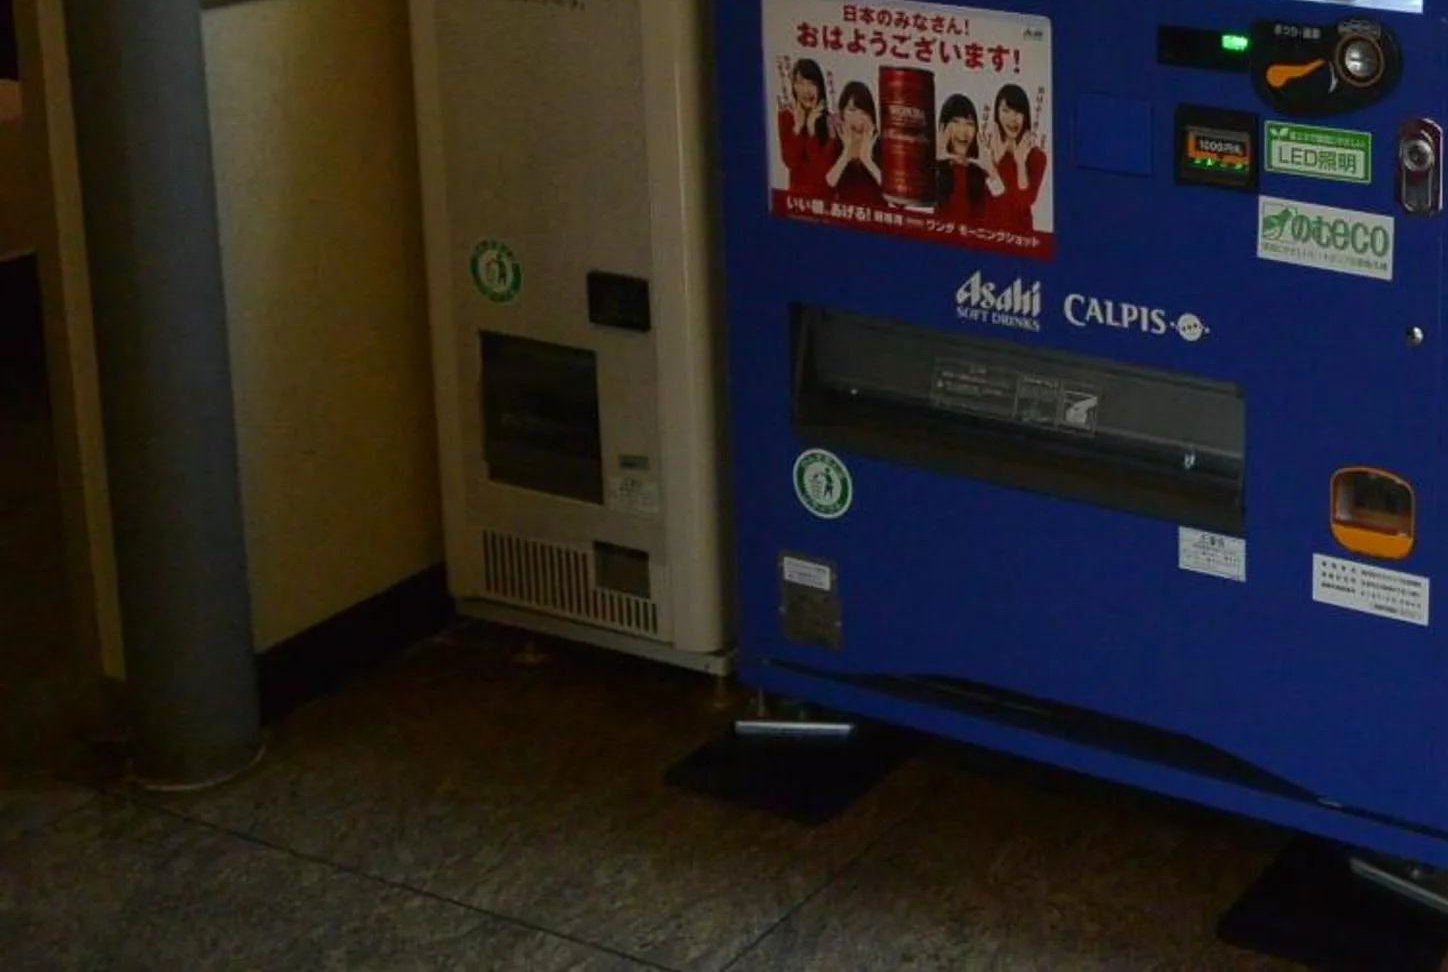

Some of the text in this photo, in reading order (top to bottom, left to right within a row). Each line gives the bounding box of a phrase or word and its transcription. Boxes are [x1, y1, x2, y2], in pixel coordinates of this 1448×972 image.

[842, 4, 970, 35] 日本のみなさん!
[796, 21, 1021, 74] おはようございます!
[1278, 146, 1357, 174] LED照明
[955, 270, 1166, 335] Asahi CALPIS
[956, 306, 1041, 333] SOFT DRINKS
